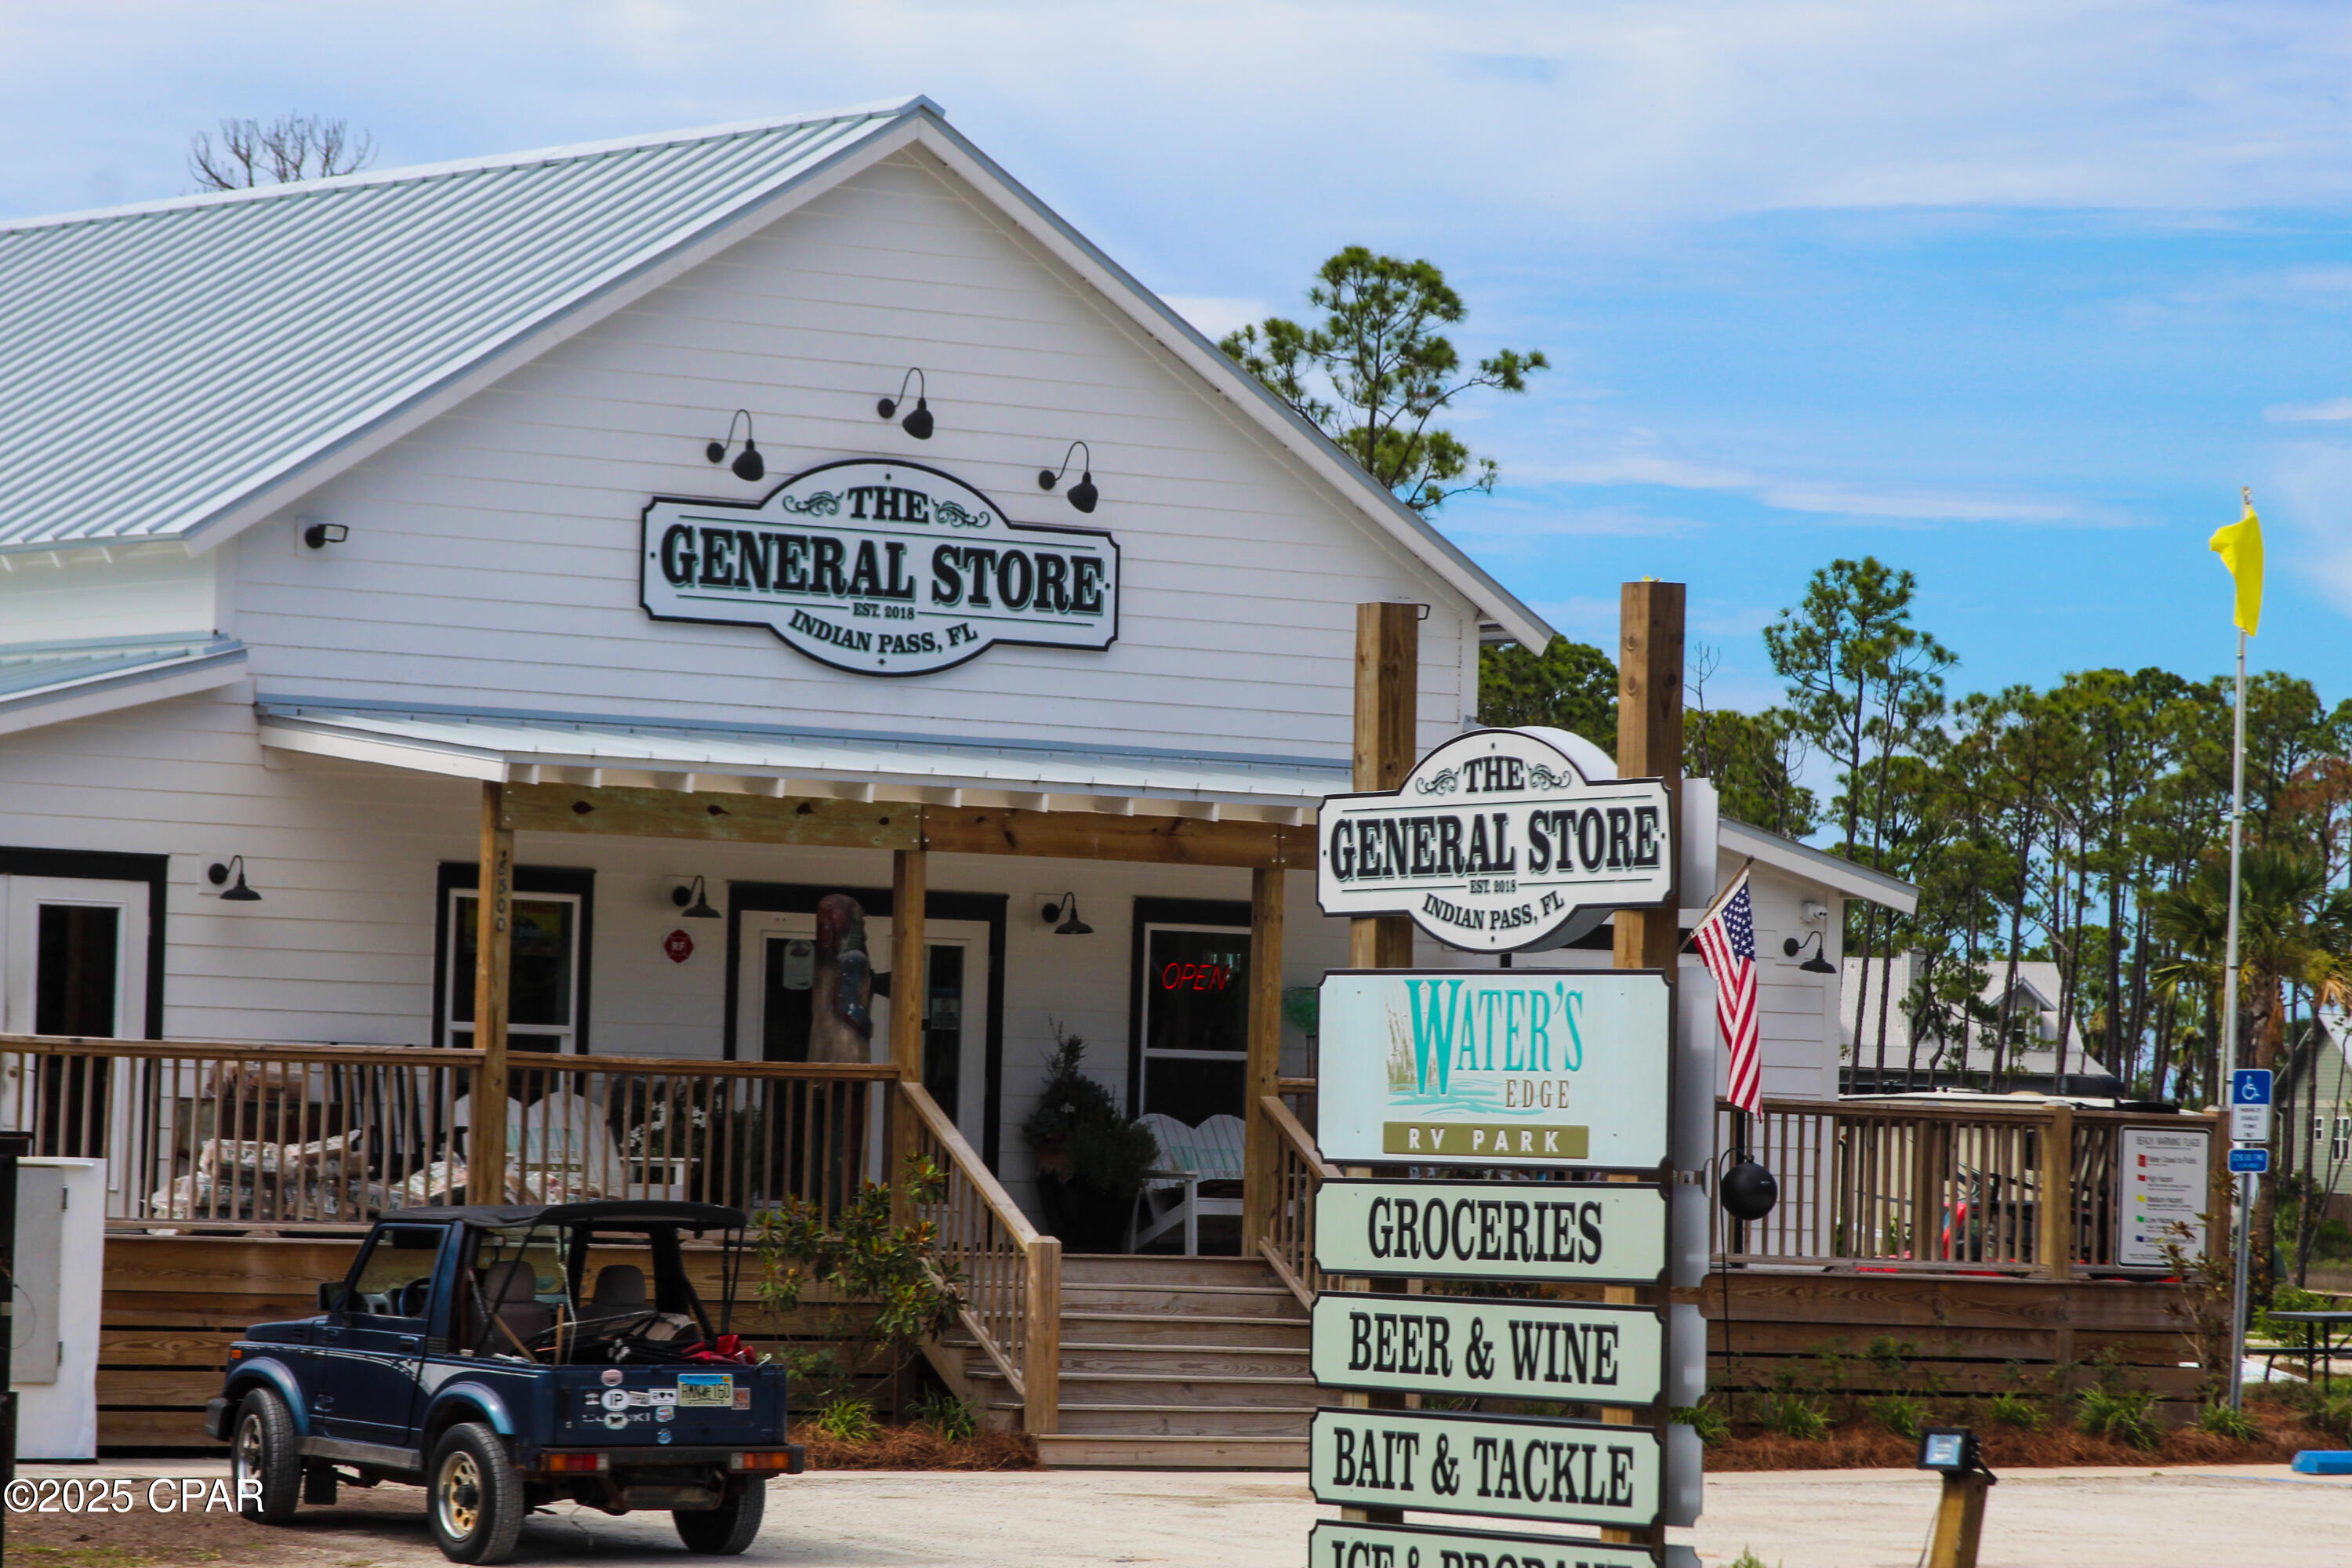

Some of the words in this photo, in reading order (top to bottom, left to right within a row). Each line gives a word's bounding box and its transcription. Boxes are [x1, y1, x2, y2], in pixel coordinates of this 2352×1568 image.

[848, 486, 930, 524] THE
[661, 524, 916, 601] GENERAL
[931, 543, 1103, 615] STORE
[789, 608, 872, 652] INDIAN
[877, 633, 943, 655] PASS,
[948, 622, 978, 648] FL
[853, 602, 880, 619] EST.
[884, 604, 915, 621] 2018
[1463, 756, 1526, 793] THE
[1331, 812, 1516, 883] GENERAL
[1527, 806, 1661, 874] STORE
[1470, 880, 1491, 894] EST.
[1494, 880, 1517, 893] 2018
[1421, 892, 1485, 930] INDIAN
[1489, 904, 1538, 931] PASS,
[1541, 890, 1565, 916] FL
[1162, 963, 1230, 990] OPEN
[1404, 979, 1584, 1094] WATER'S
[1505, 1079, 1569, 1109] EDGE
[1409, 1127, 1445, 1149] RV
[1472, 1129, 1559, 1153] PARK
[1368, 1196, 1602, 1265] GROCERIES
[1348, 1311, 1453, 1377] BEER
[1465, 1317, 1494, 1380] &
[1508, 1319, 1619, 1386] WINE
[1333, 1427, 1419, 1491] BAIT
[1432, 1433, 1460, 1496] &
[1473, 1436, 1633, 1508] TACKLE
